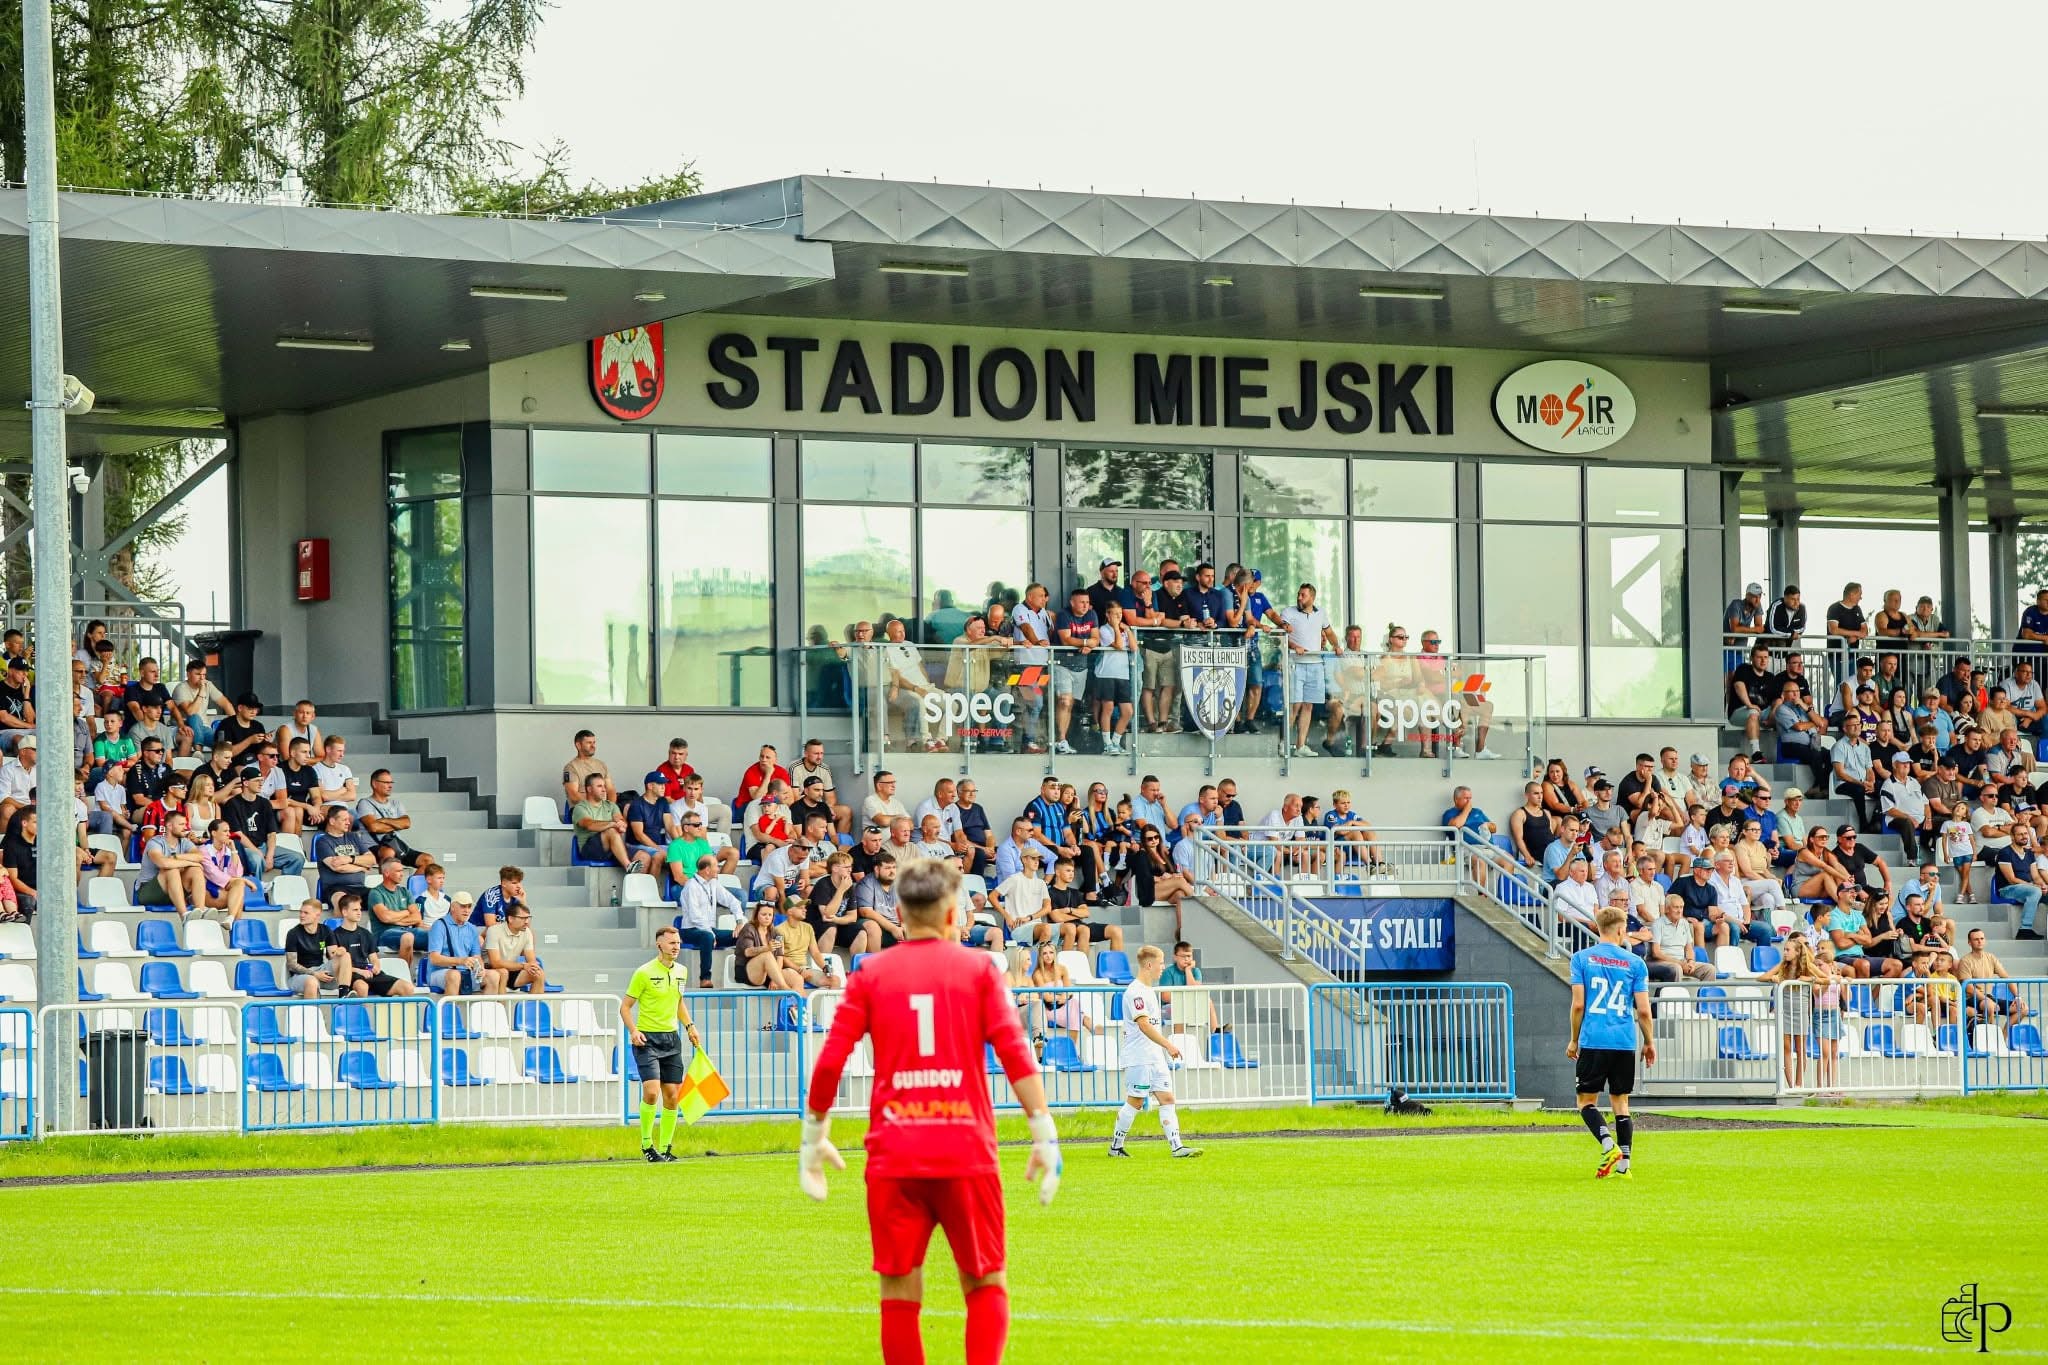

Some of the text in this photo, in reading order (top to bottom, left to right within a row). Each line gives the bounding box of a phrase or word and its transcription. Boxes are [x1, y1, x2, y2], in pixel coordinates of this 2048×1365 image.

[706, 333, 1454, 435] STADION MIEJSKI
[923, 691, 1016, 737] spec
[981, 728, 1013, 737] SERVICE
[1377, 699, 1462, 742] spec
[1349, 918, 1373, 949] ZE
[1379, 918, 1443, 949] STALI!
[1589, 976, 1626, 1017] 24
[909, 993, 935, 1057] 1
